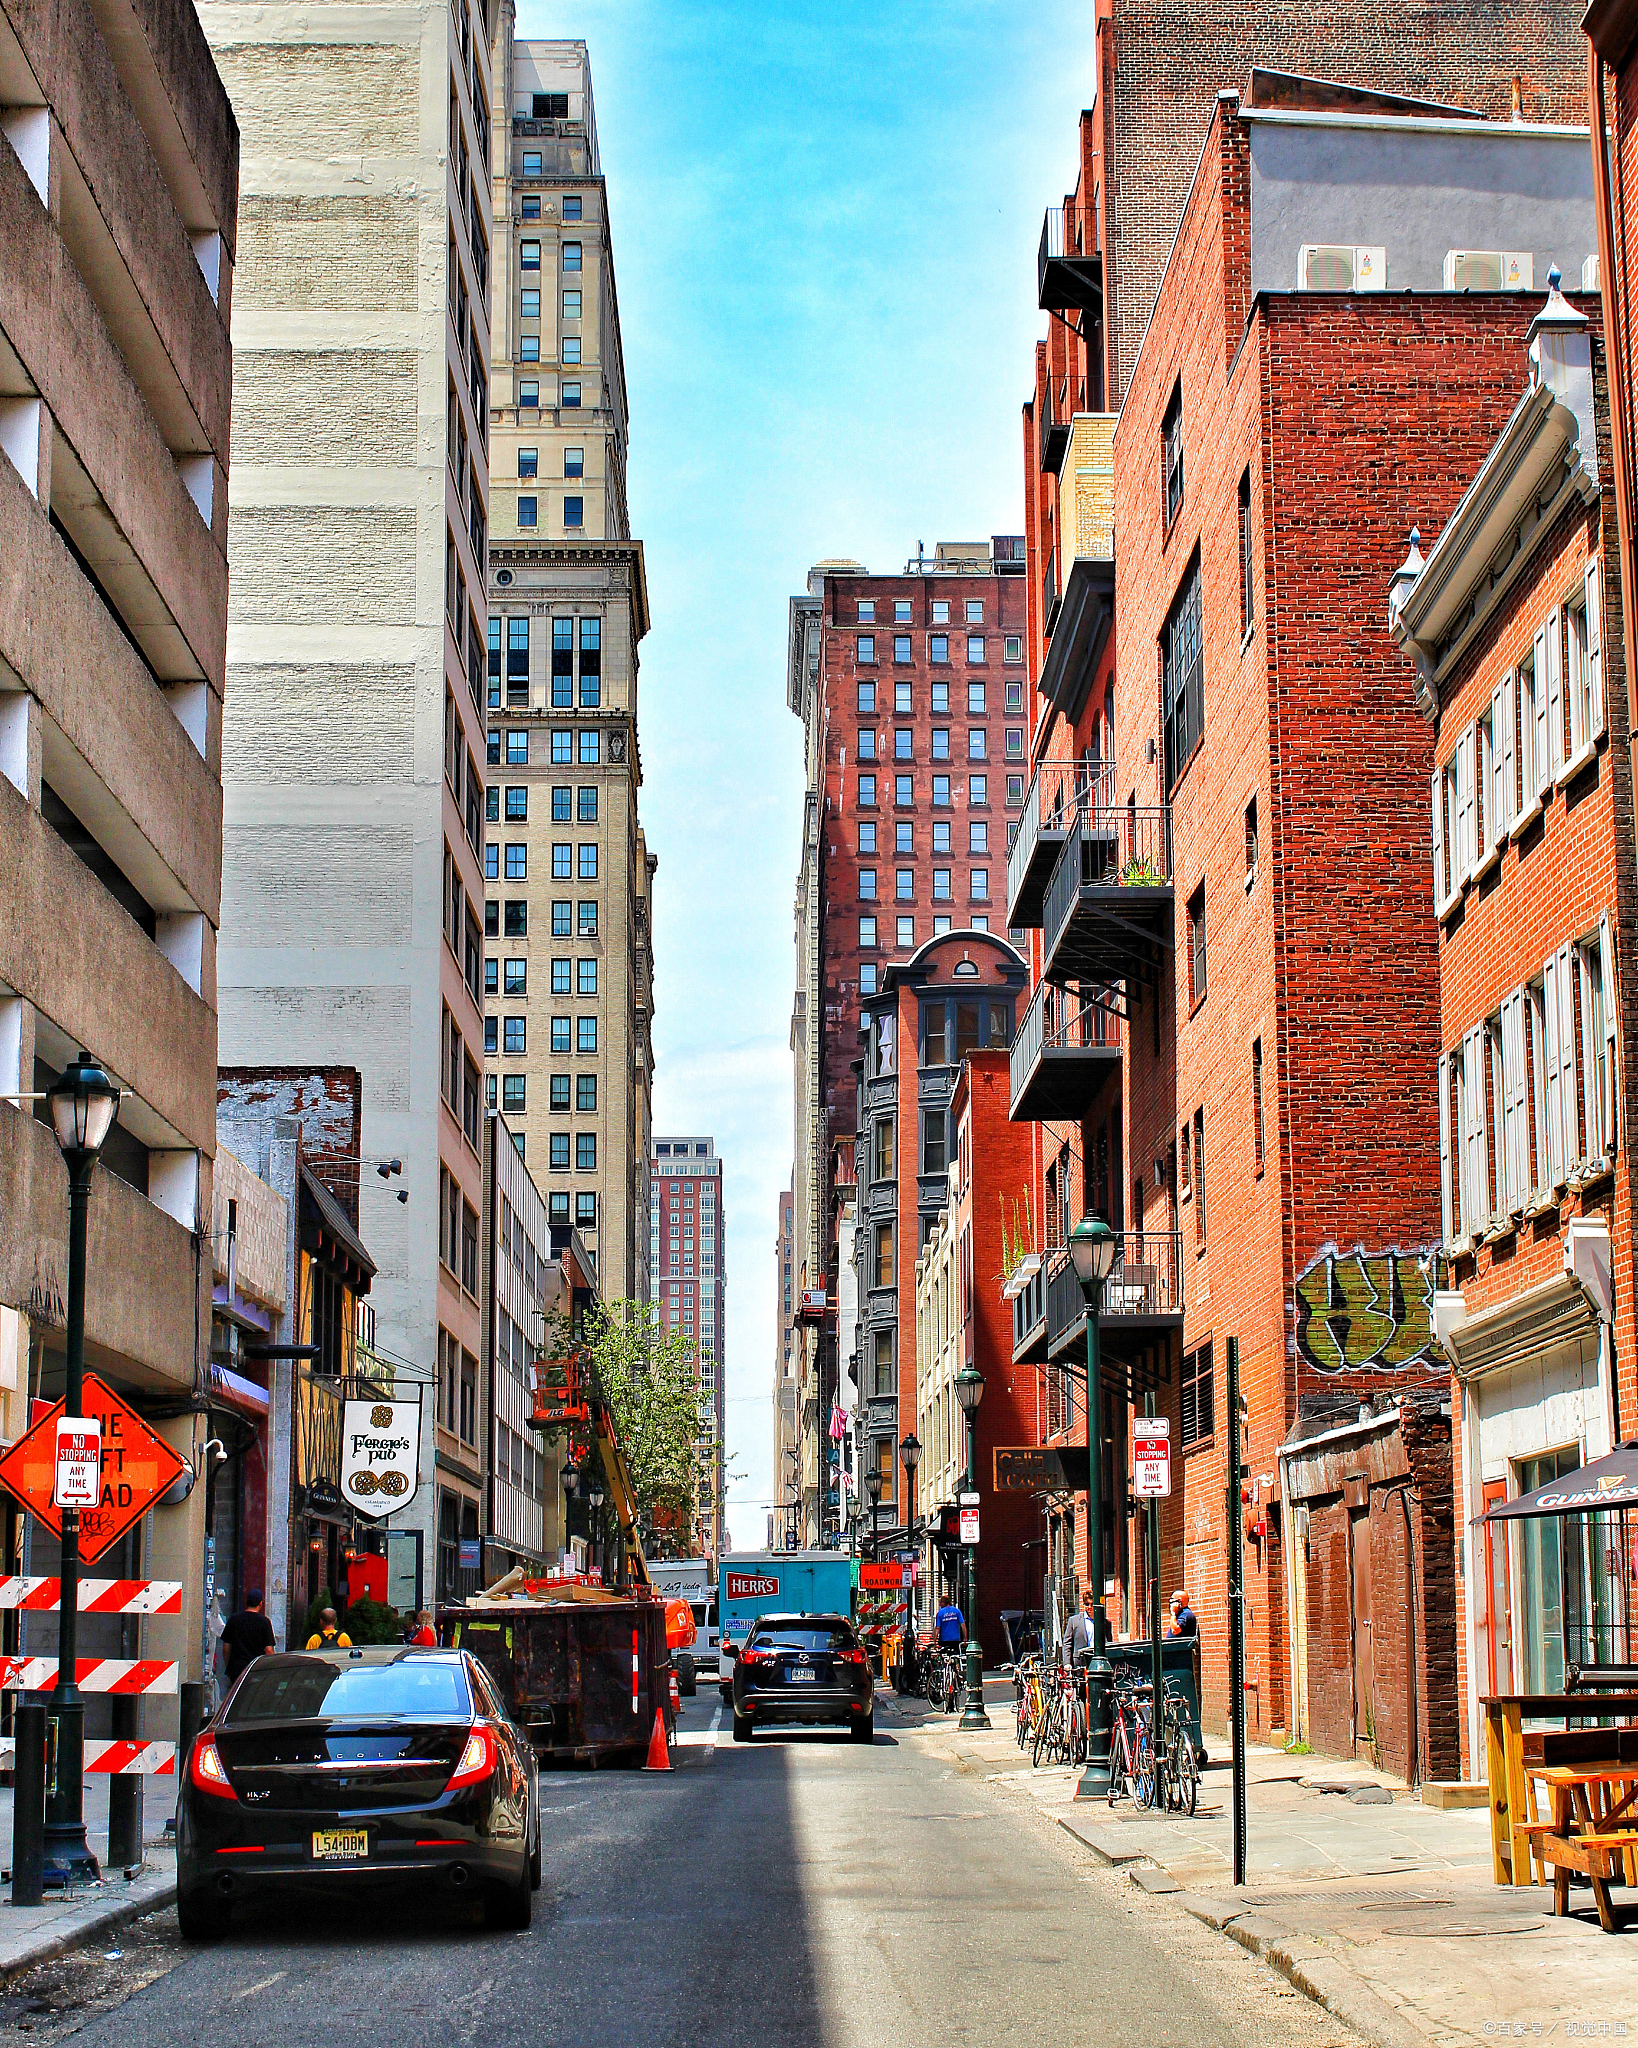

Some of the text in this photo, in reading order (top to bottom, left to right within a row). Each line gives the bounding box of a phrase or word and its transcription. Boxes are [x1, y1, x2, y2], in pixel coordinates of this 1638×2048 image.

[72, 1435, 85, 1449] NO
[1146, 1441, 1156, 1450] NO
[60, 1448, 97, 1461] STOPPING
[368, 1449, 397, 1466] pub
[1136, 1450, 1167, 1459] STOPPING
[999, 1452, 1043, 1469] Cella
[69, 1466, 86, 1476] ANY
[1144, 1463, 1160, 1472] ANY
[998, 1469, 1058, 1487] Luxuria
[1144, 1473, 1161, 1483] TIME
[67, 1478, 87, 1489] TIME
[878, 1566, 891, 1574] END
[731, 1578, 774, 1594] HERR'S
[275, 1751, 406, 1761] LINCOLN
